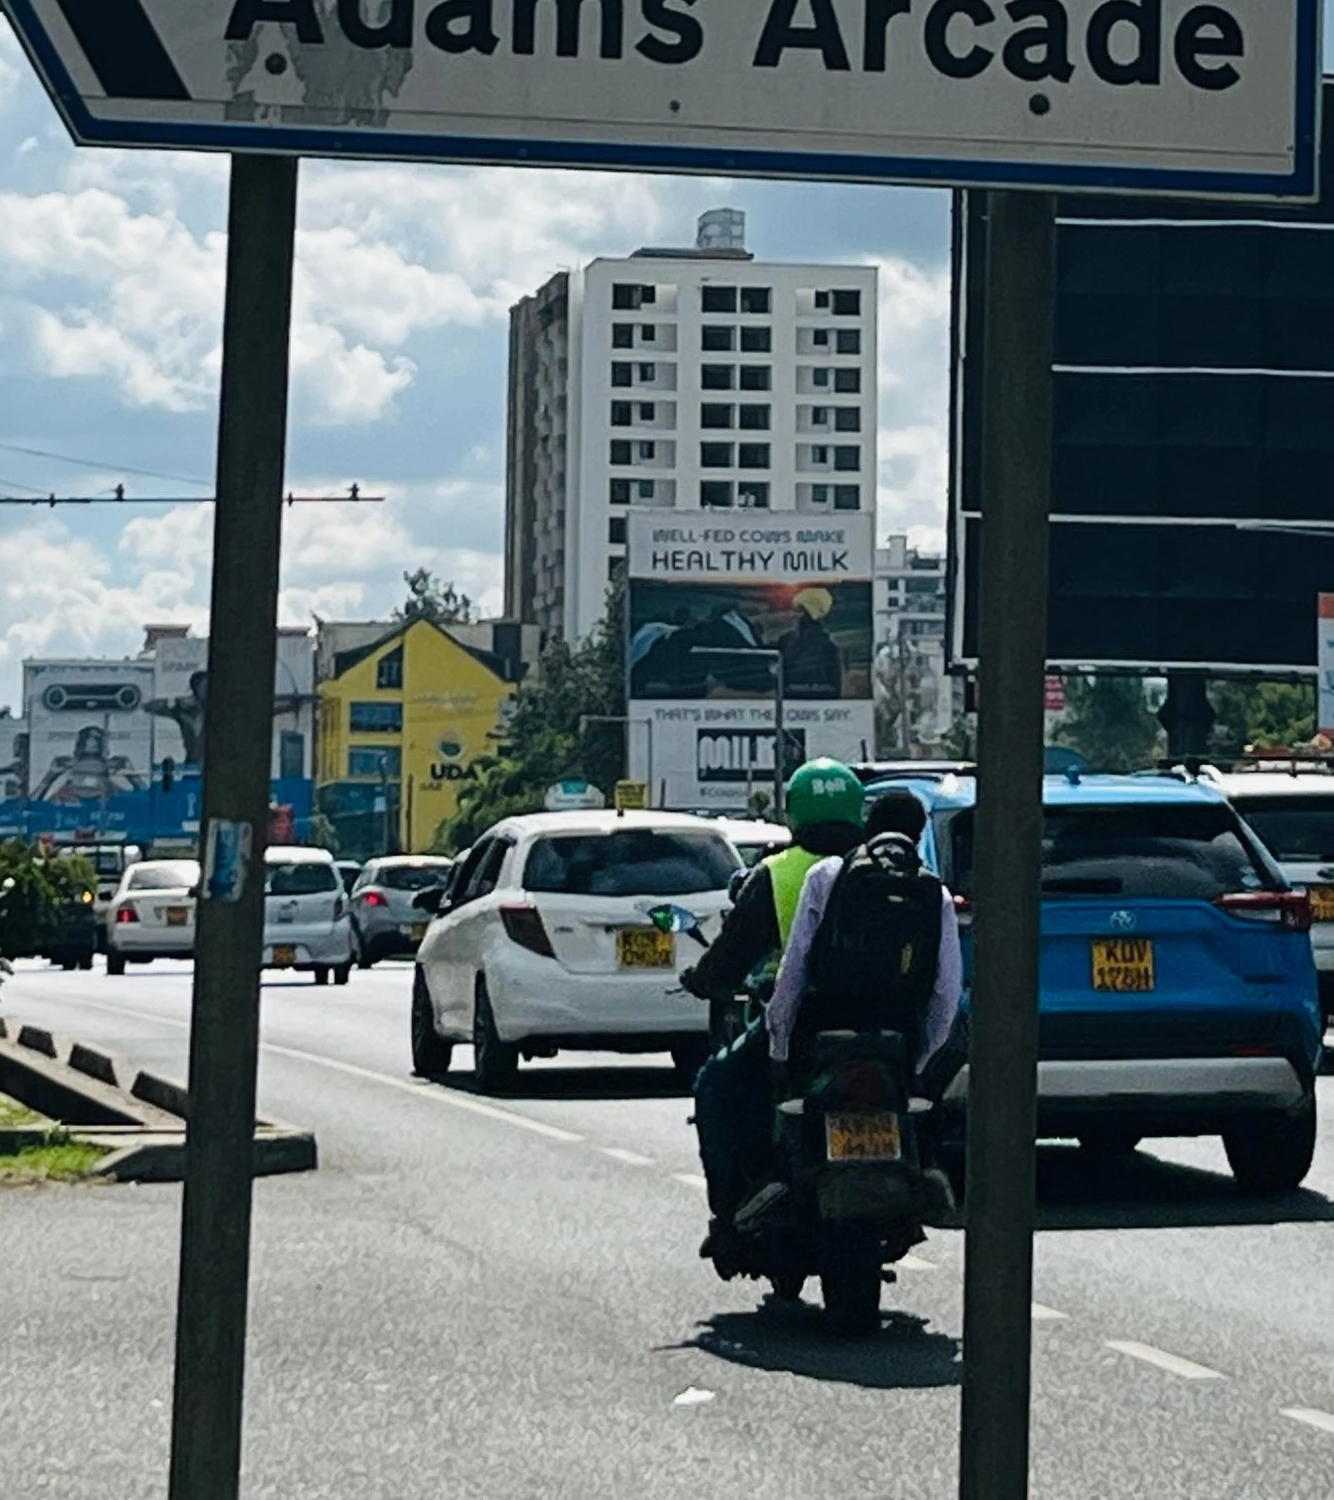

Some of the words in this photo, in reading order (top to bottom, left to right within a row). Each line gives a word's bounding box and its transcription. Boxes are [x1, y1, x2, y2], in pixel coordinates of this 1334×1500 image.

[739, 529, 792, 544] COWS
[652, 551, 774, 572] HEALTHY
[783, 551, 849, 572] MILK
[430, 763, 478, 781] UDA
